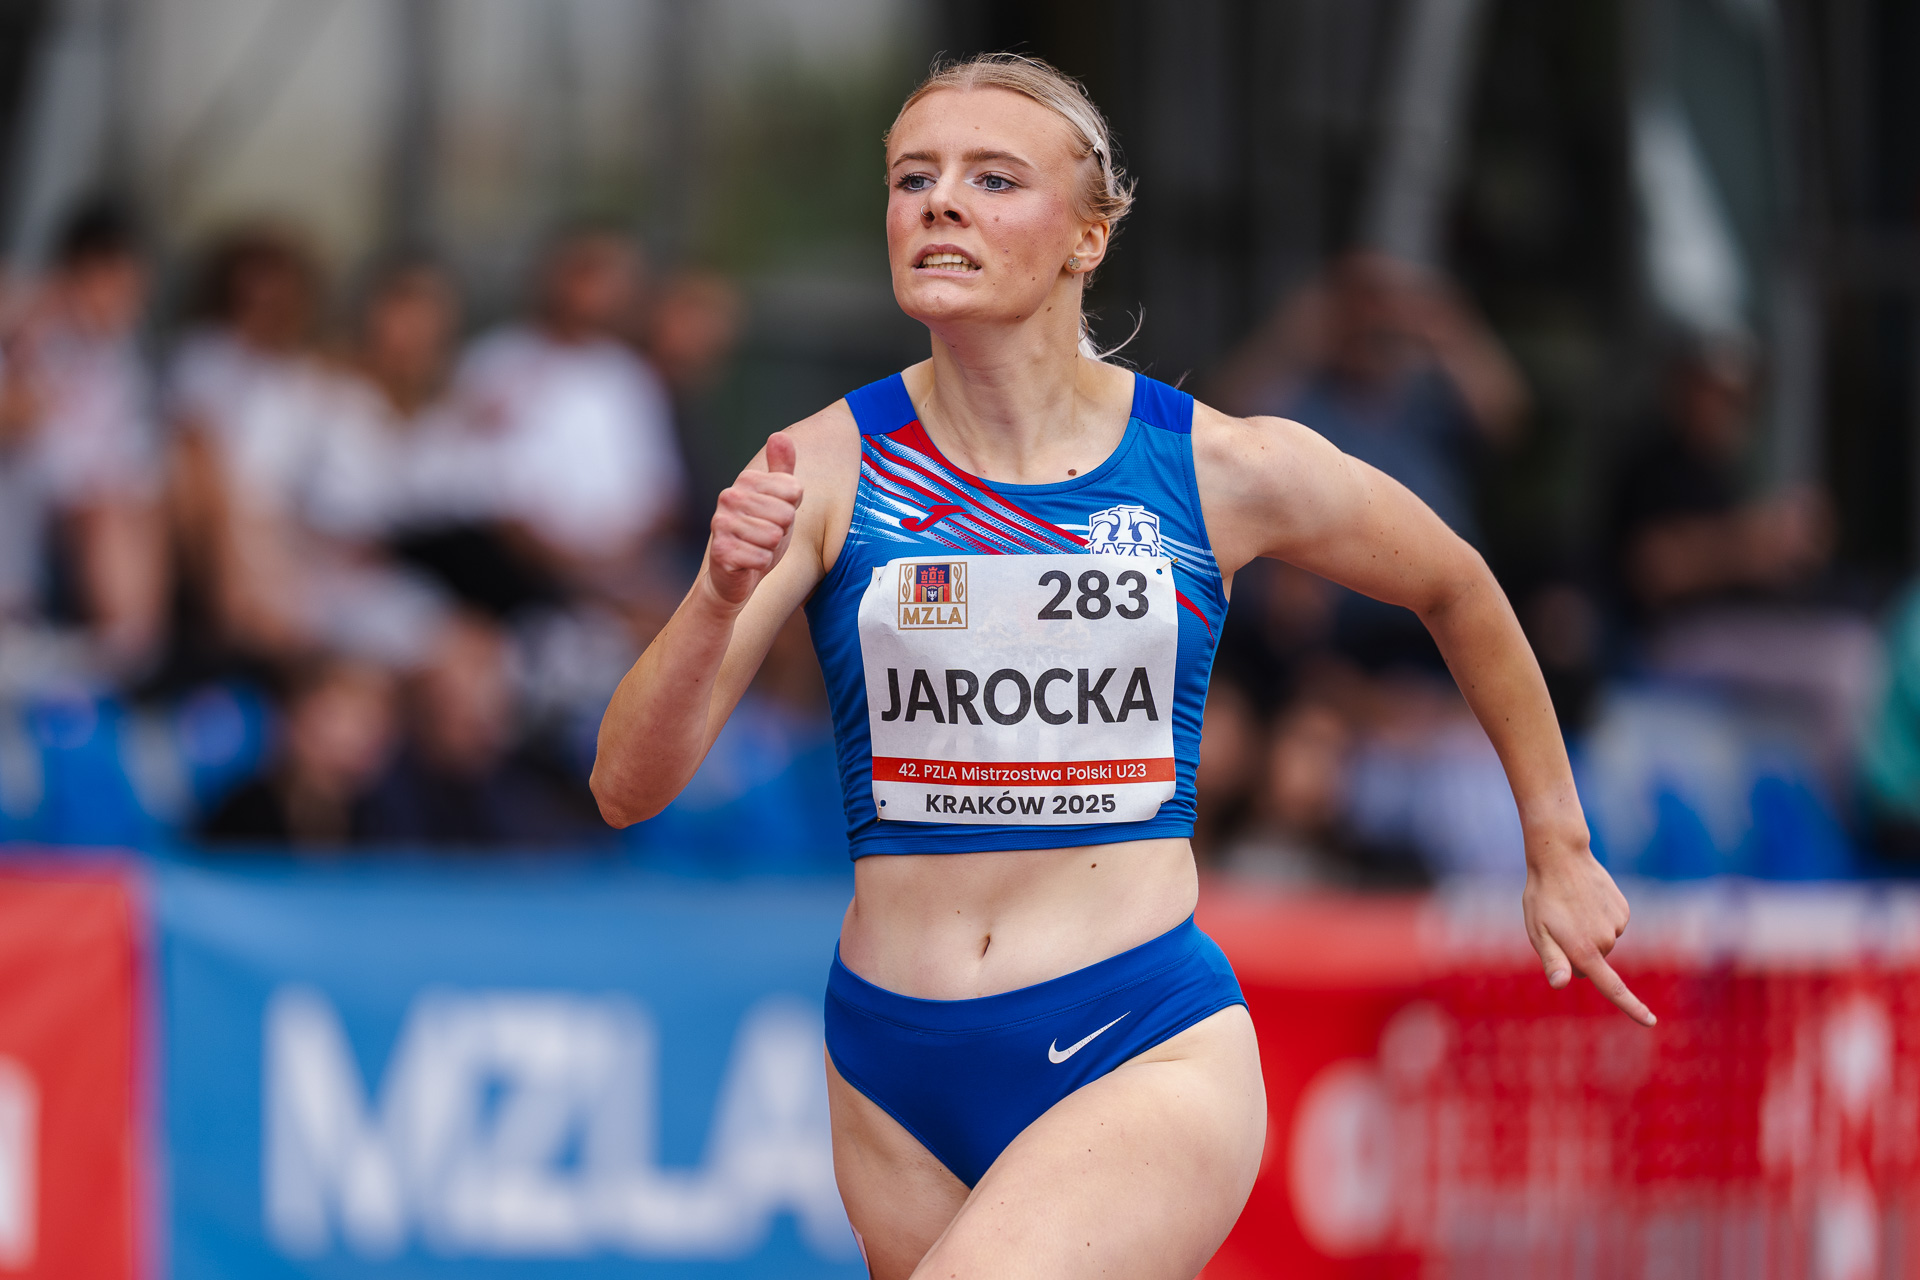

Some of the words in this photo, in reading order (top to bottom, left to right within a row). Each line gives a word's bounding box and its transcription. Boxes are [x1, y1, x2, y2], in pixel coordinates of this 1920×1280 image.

[1037, 570, 1149, 620] 283
[902, 606, 963, 625] MZLA
[881, 667, 1159, 726] JAROCKA
[898, 763, 920, 777] 42.
[924, 764, 957, 780] PZLA
[961, 766, 1062, 781] Mistrzostwa
[1066, 764, 1112, 780] Polski
[1116, 763, 1147, 778] U23
[926, 790, 1045, 815] KRAKÓW
[1052, 794, 1116, 814] 2025
[264, 985, 856, 1260] MZLA
